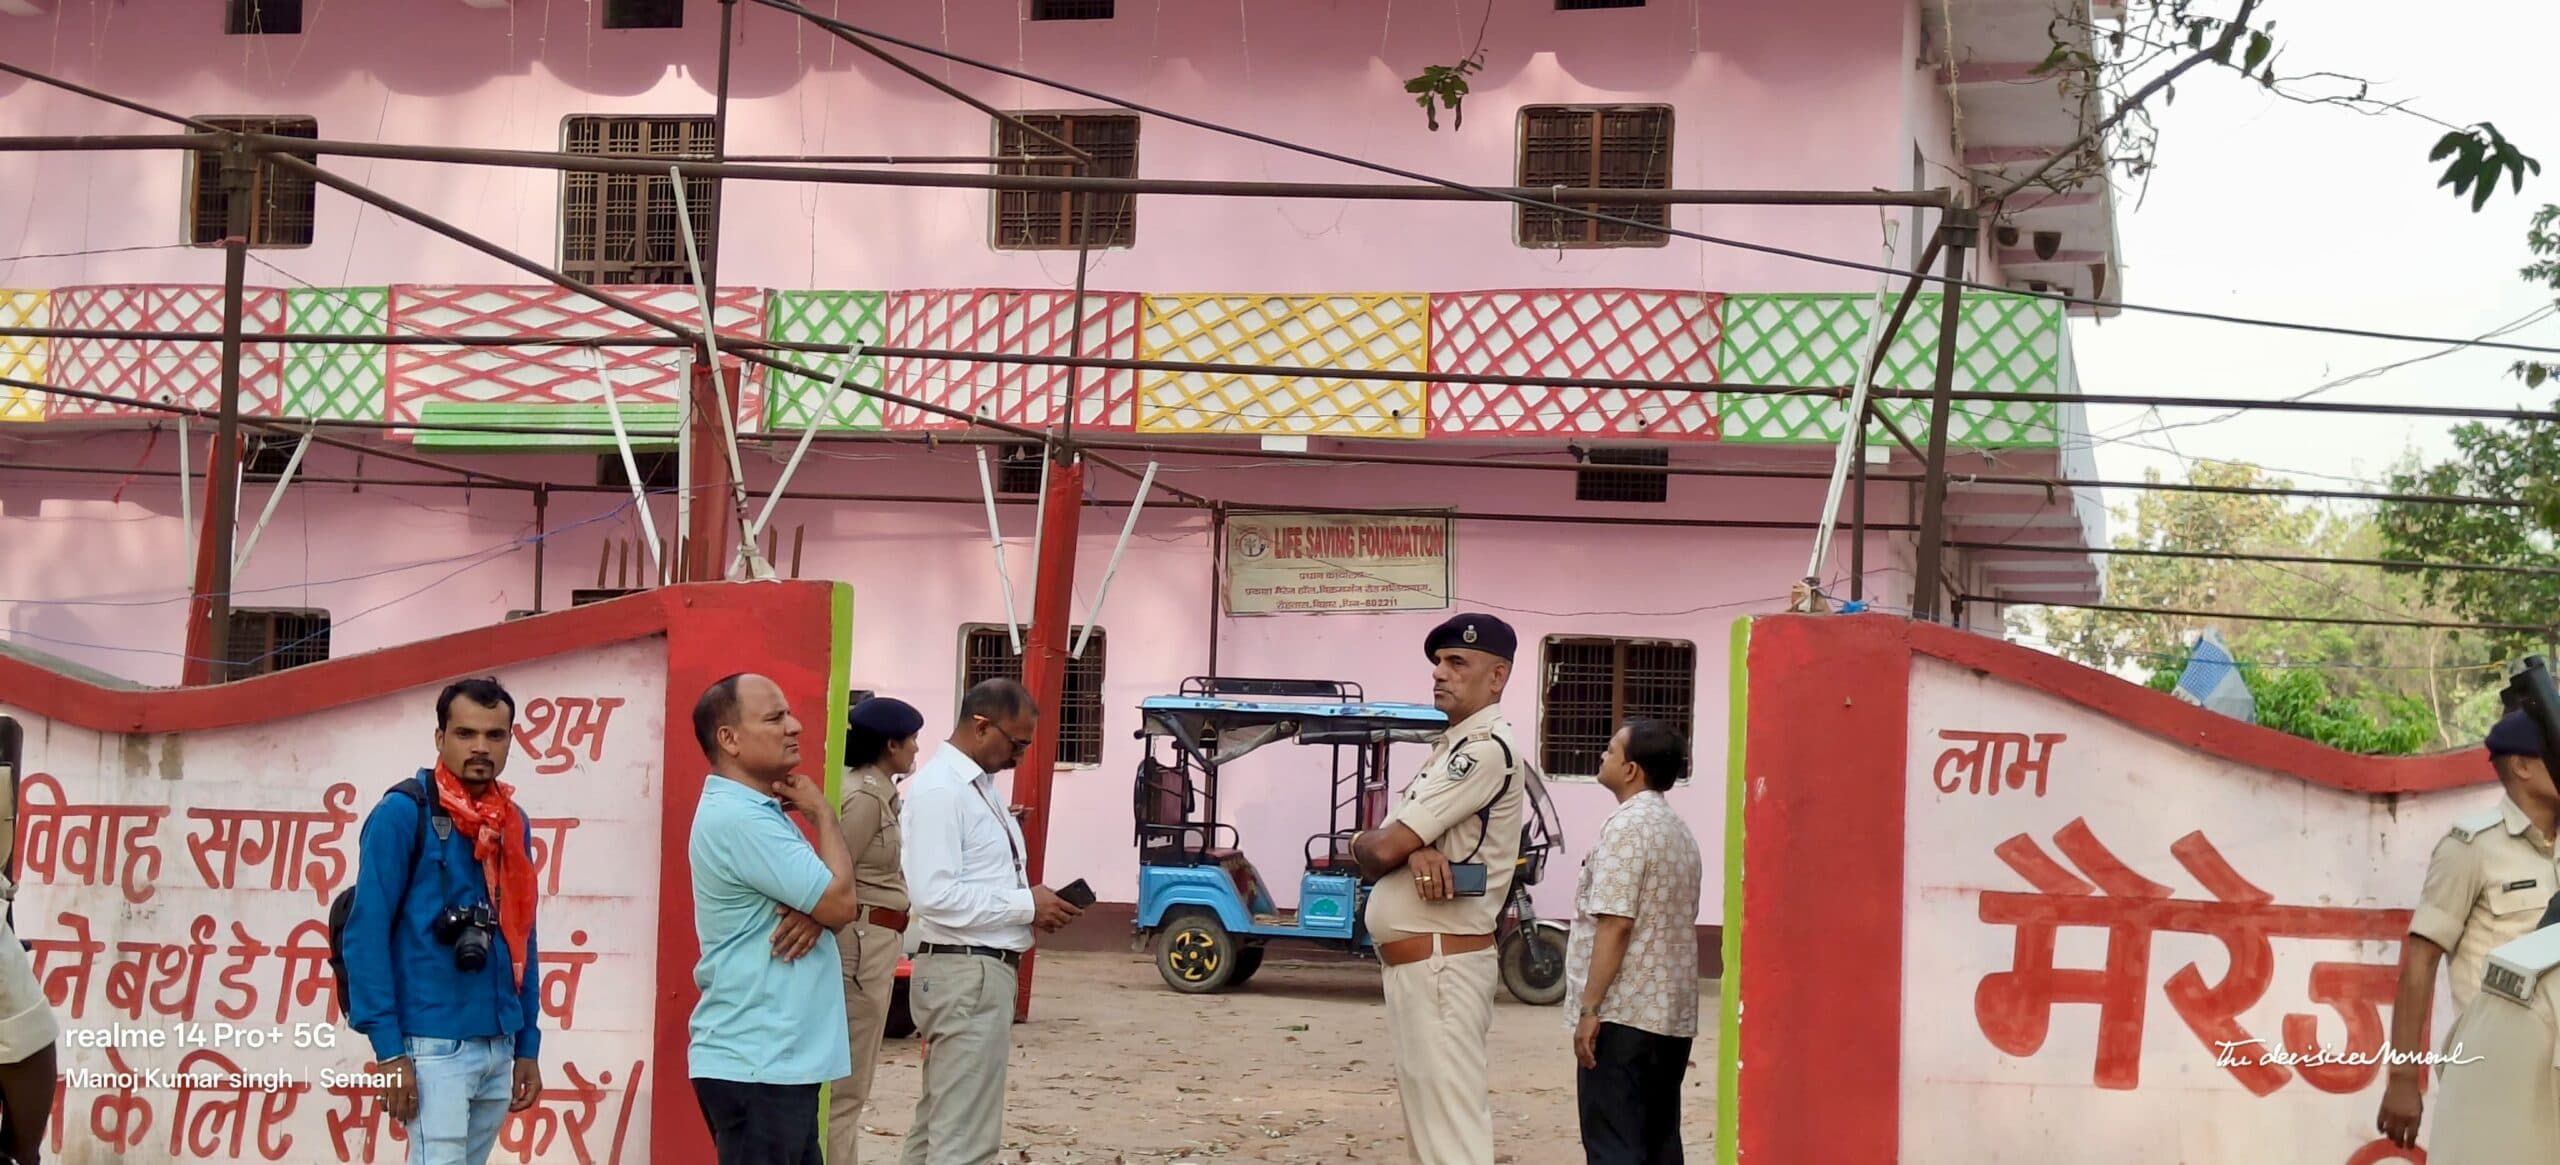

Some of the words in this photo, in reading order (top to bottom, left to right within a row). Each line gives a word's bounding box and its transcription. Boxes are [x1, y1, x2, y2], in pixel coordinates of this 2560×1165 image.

[1274, 527, 1303, 559] LIFE
[1305, 526, 1355, 559] SAVING
[1358, 525, 1443, 558] FOUNDATION
[512, 696, 626, 775] शुभ
[1933, 729, 2067, 798] लाभ
[12, 772, 170, 904] विवाह
[186, 782, 358, 906] सगाई
[106, 914, 217, 1022] बर्थ
[215, 920, 271, 1020] डे
[1974, 816, 2432, 1098] मैरेज
[90, 1046, 154, 1157] के
[168, 1048, 312, 1160] लिए
